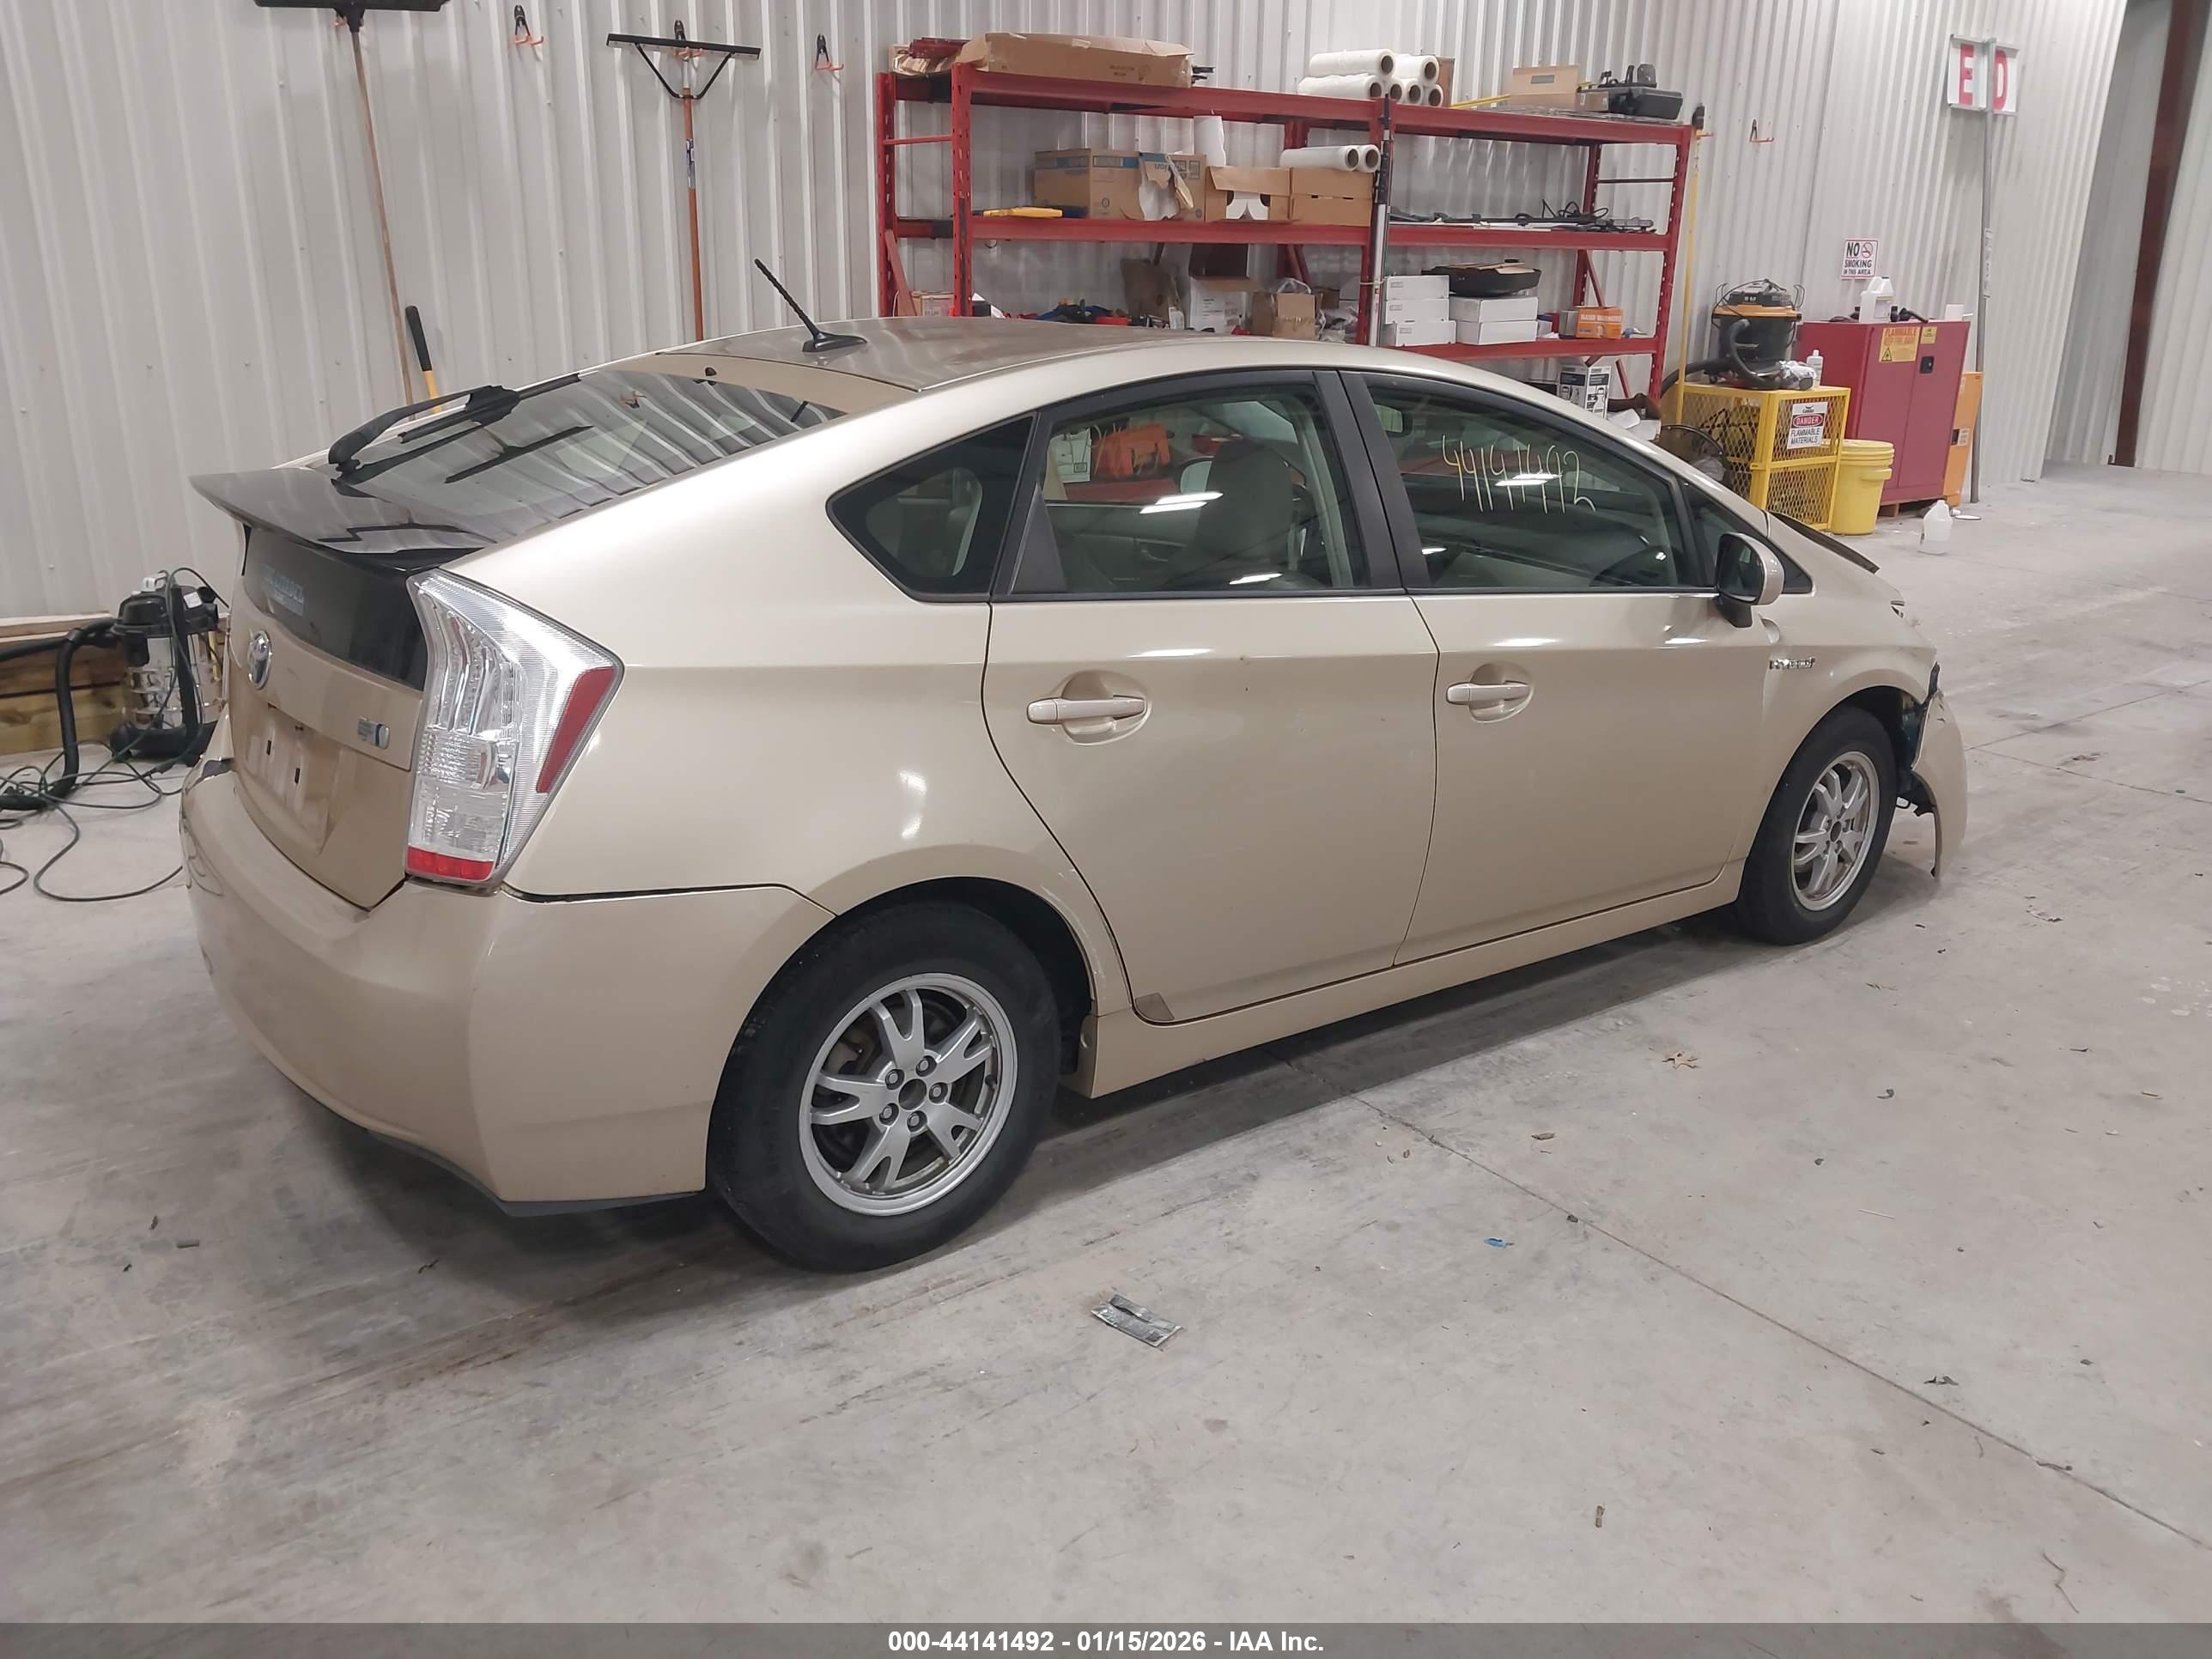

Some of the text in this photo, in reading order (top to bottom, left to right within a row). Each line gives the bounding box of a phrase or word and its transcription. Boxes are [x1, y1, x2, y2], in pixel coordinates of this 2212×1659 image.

[1959, 43, 1974, 106] E
[1993, 49, 2008, 111] D
[1846, 241, 1860, 257] NO
[1844, 259, 1872, 268] SMOKING
[1796, 416, 1820, 425] DANGER
[1791, 428, 1820, 436] FLAMMABLE
[1790, 435, 1818, 445] MATERIALS
[1443, 434, 1596, 514] 44141492
